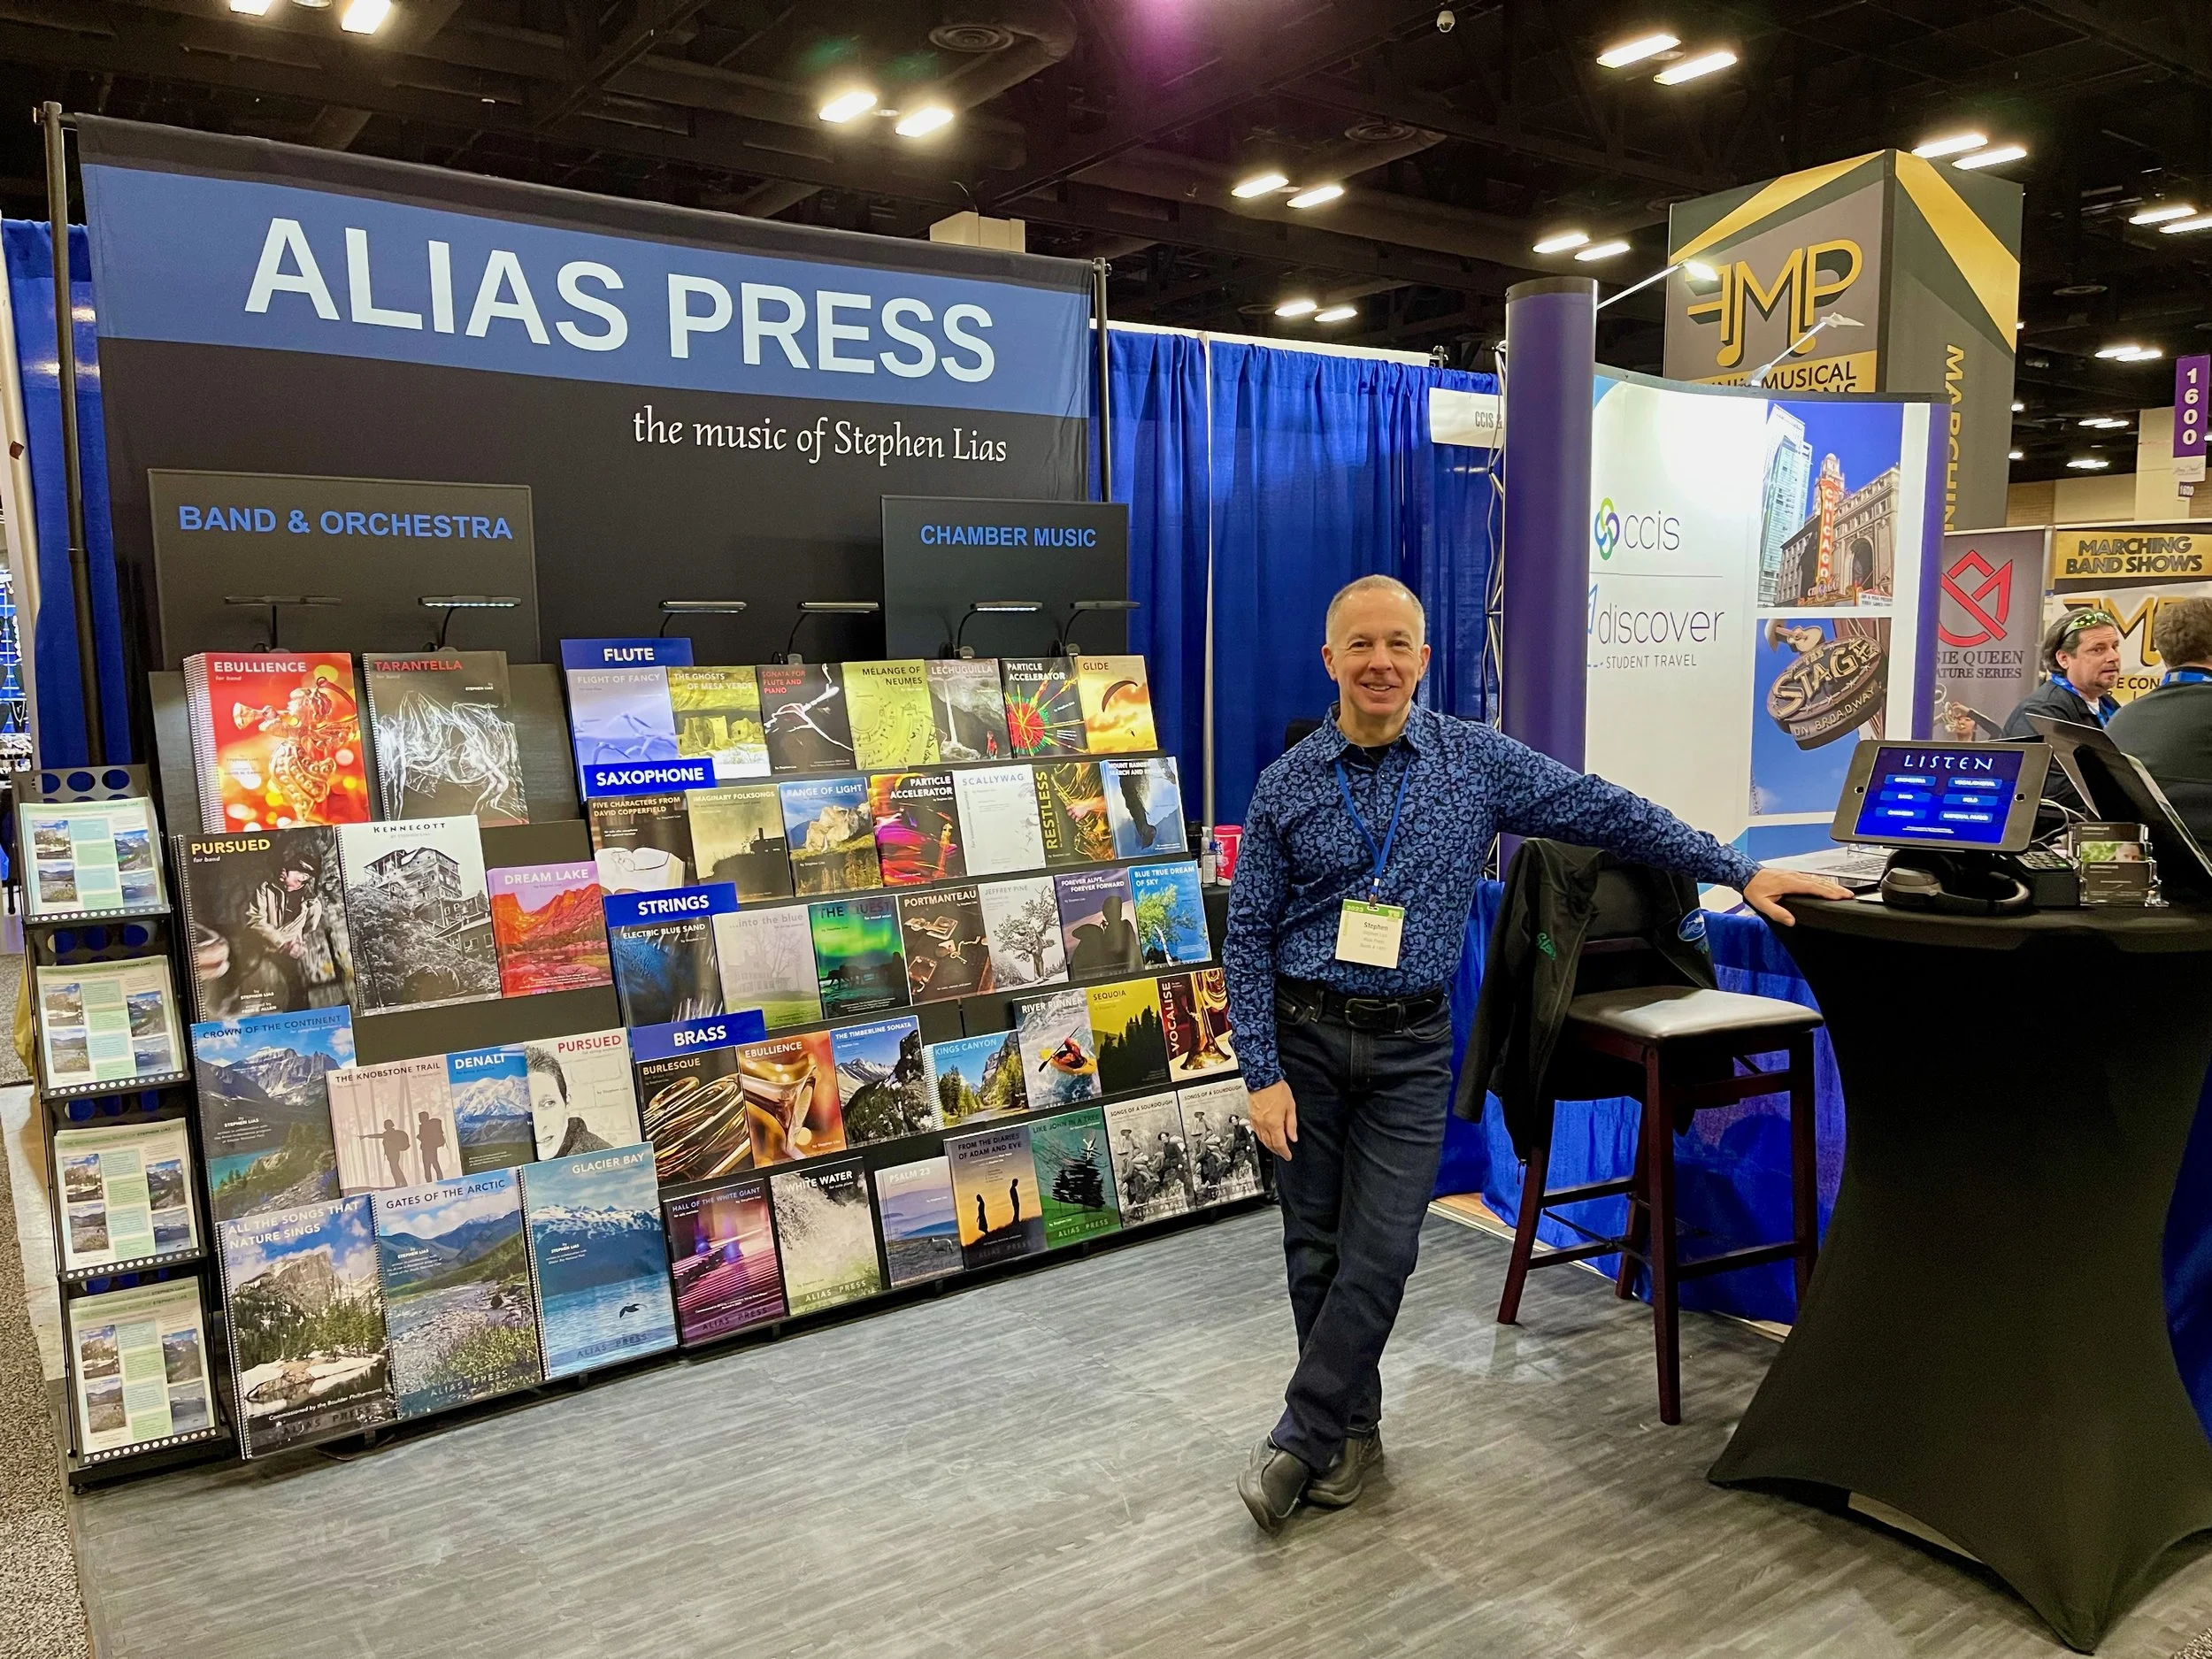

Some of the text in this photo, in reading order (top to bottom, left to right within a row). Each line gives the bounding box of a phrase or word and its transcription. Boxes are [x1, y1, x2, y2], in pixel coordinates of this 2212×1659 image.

[244, 217, 996, 383] ALIAS PRESS
[1762, 361, 1856, 389] MUSICAL
[2182, 367, 2199, 445] 1600
[1475, 411, 1494, 428] CCIS
[632, 404, 1008, 466] the music of Stephen Lias
[179, 505, 513, 540] BAND & ORCHESTRA
[1623, 510, 1681, 551] ccis
[920, 524, 1097, 549] CHAMBER MUSIC
[1820, 488, 1834, 576] CHICAGO
[2078, 536, 2193, 556] MARCHING
[2065, 555, 2203, 574] BAND SHOWS
[1598, 603, 1725, 645] discover
[603, 647, 655, 662] FLUTE
[1606, 652, 1697, 669] STUDENT TRAVEL
[1963, 651, 2024, 666] QUEEN
[214, 662, 307, 672] EBULLIENCE
[374, 660, 463, 672] TARANTELLA
[862, 665, 906, 676] MÉLANGE
[931, 665, 994, 675] LECHUGUILLA
[1007, 663, 1043, 672] PARTICLE
[1083, 662, 1109, 671] GLIDE
[1977, 668, 2022, 678] SERIES
[628, 673, 661, 682] FANCY
[886, 677, 923, 686] NEUMES
[1009, 672, 1066, 681] ACCELERATOR
[1772, 639, 1881, 719] STAGE
[1815, 686, 1875, 730] BROADWAY
[1904, 755, 1993, 770] LISTEN
[595, 767, 704, 787] SAXOPHONE
[910, 775, 951, 787] PARTICLE
[962, 773, 1025, 787] SCALLYWAG
[693, 791, 775, 803] IMAGINARY FOLKSONGS
[786, 787, 819, 797] RANGE
[835, 784, 863, 794] LIGHT
[889, 787, 954, 800] ACCELERATOR
[607, 798, 657, 809] CHARACTERS
[658, 796, 681, 805] FROM
[1036, 771, 1058, 849] RESTLESS
[594, 806, 667, 817] DAVID COPPERFIELD
[373, 823, 445, 833] KENNECOTT
[190, 839, 271, 856] PURSUED
[504, 869, 588, 885] DREAM LAKE
[1134, 865, 1194, 879] BLUE TRUE DREAM
[985, 884, 1028, 895] JEFFREY PINE
[1061, 879, 1090, 887] FOREVER
[1071, 880, 1125, 893] FOREVER FORWARD
[1146, 878, 1159, 887] SKY
[637, 895, 710, 916] STRINGS
[903, 890, 977, 909] PORTMANTEAU
[622, 923, 706, 941] ELECTRIC BLUE SAND
[1364, 922, 1388, 931] Stephen
[1092, 989, 1126, 1001] SEQUOIA
[1022, 995, 1083, 1014] RIVER RUNNER
[1162, 982, 1180, 1052] VOCALISE
[203, 1028, 242, 1039] CROWN
[246, 1025, 259, 1034] OF
[284, 1015, 342, 1028] CONTINENT
[835, 1021, 911, 1041] THE TIMBERLINE SONATA
[557, 1035, 622, 1054] PURSUED
[672, 1025, 727, 1047] BRASS
[744, 1041, 803, 1059] EBULLIENCE
[934, 1037, 997, 1056] KINGS CANYON
[455, 1053, 505, 1070] DENALI
[642, 1057, 702, 1076] BURLESQUE
[335, 1062, 441, 1084] THE KNOBSTONE TRAIL
[1141, 1100, 1173, 1110] SOURDOUGH
[994, 1133, 1019, 1143] DIARIES
[970, 1148, 989, 1157] ADAM
[572, 1152, 646, 1175] GLACIER BAY
[785, 1170, 853, 1193] WHITE WATER
[889, 1168, 931, 1184] PSALM 23
[386, 1179, 506, 1210] GATES OF THE ARCTIC
[717, 1192, 737, 1202] WHITE
[739, 1187, 760, 1197] GIANT
[228, 1201, 360, 1235] ALL THE SONGS THAT
[230, 1223, 321, 1249] NATURE SINGS
[1059, 1219, 1109, 1238] ALIAS PRESS
[805, 1279, 867, 1302] ALIAS PRESS
[576, 1333, 649, 1359] ALIAS PRESS
